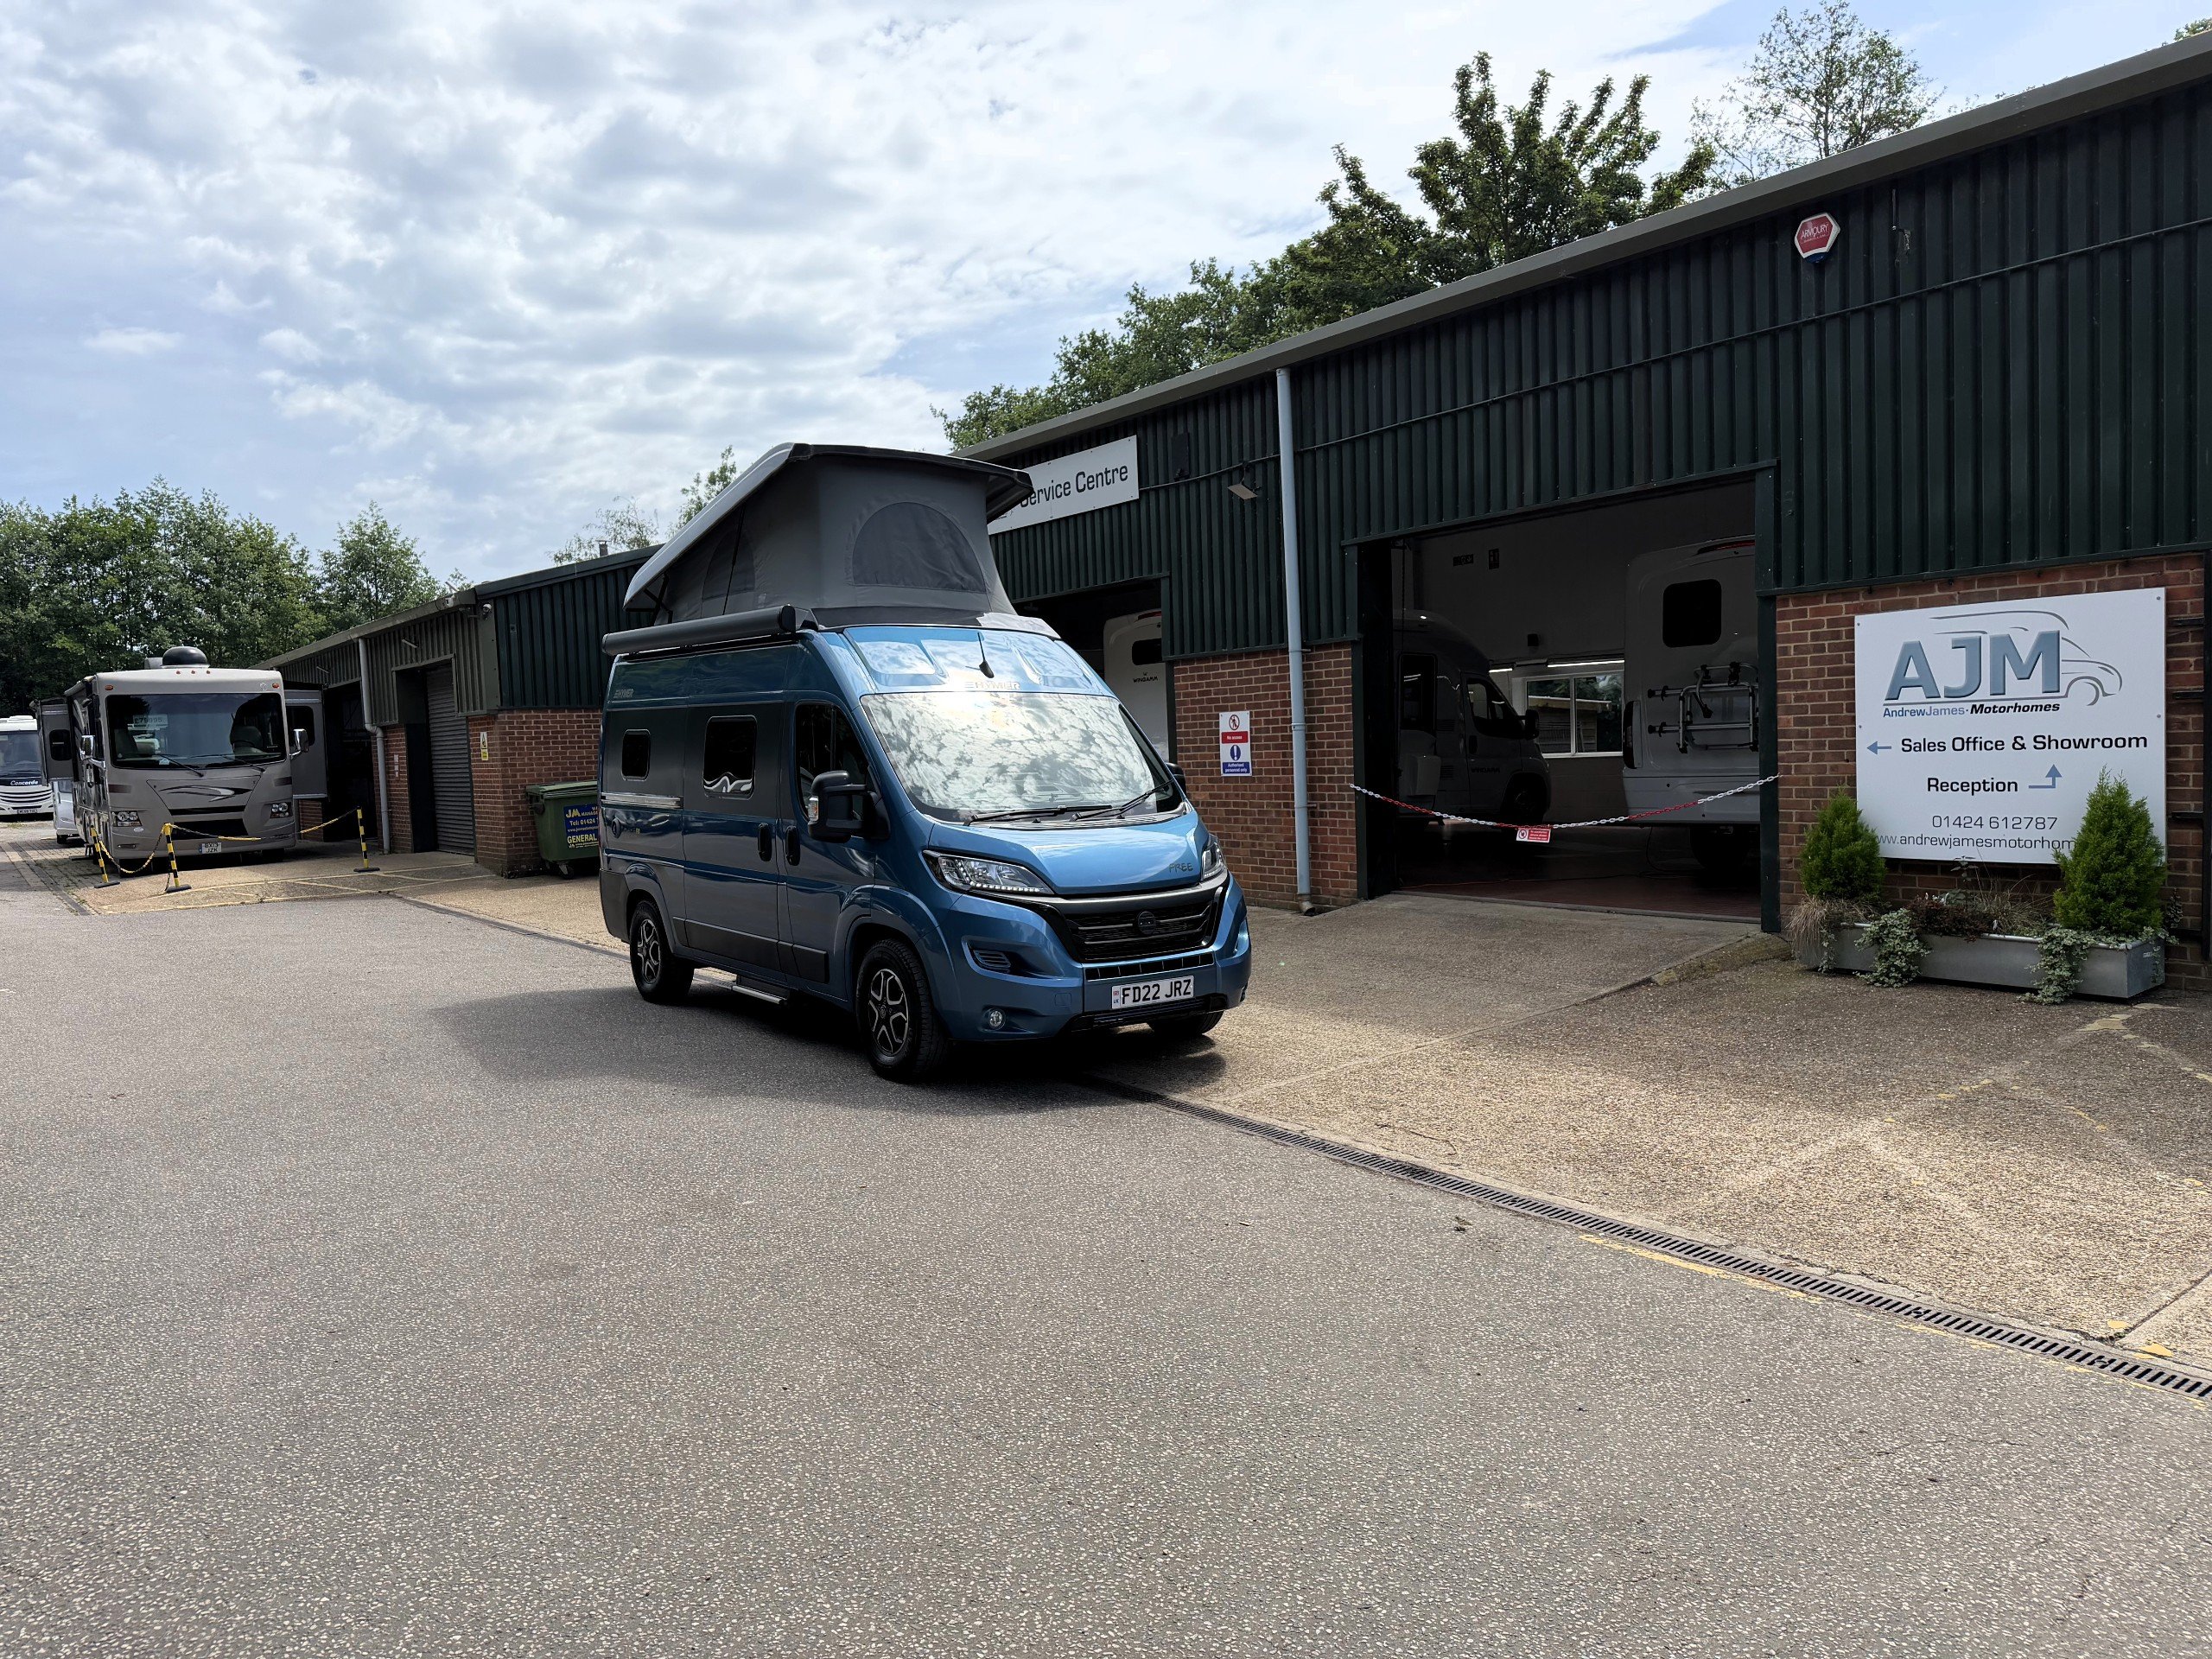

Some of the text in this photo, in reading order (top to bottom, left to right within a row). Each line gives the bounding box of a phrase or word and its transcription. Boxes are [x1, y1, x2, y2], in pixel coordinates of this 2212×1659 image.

[1801, 224, 1829, 238] ARMOURY
[1075, 465, 1128, 493] Centre
[1884, 629, 2061, 702] AJM
[1900, 734, 2149, 753] Sales Office & Showroom
[1927, 777, 2018, 796] Reception
[565, 808, 582, 818] JM
[1932, 815, 2058, 830] 01424 612787
[567, 833, 597, 843] GENERAL
[1168, 862, 1193, 873] FREE
[1122, 979, 1192, 1005] FD22 JRZ
